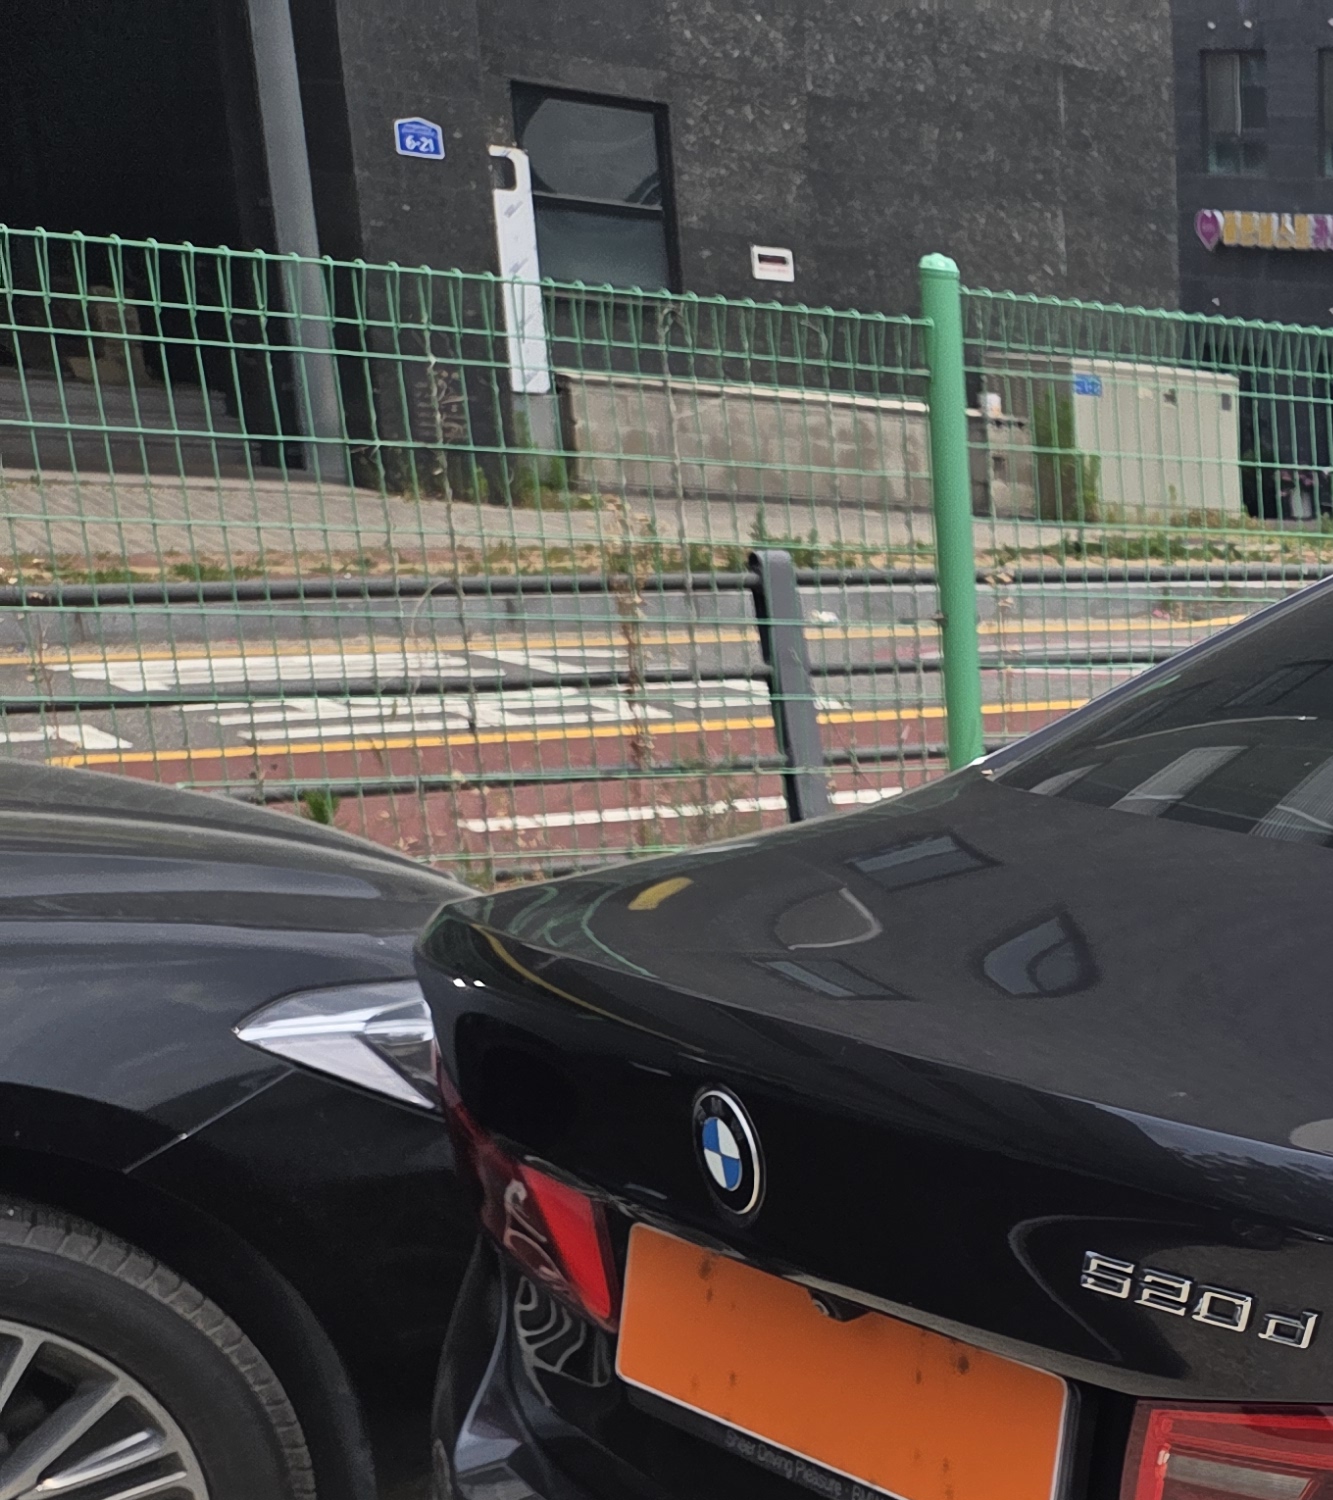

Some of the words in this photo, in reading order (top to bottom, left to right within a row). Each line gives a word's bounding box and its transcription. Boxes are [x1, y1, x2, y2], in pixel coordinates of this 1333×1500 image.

[405, 135, 434, 152] 6-21
[1080, 1250, 1319, 1349] 520d
[794, 1459, 843, 1497] Pleasure
